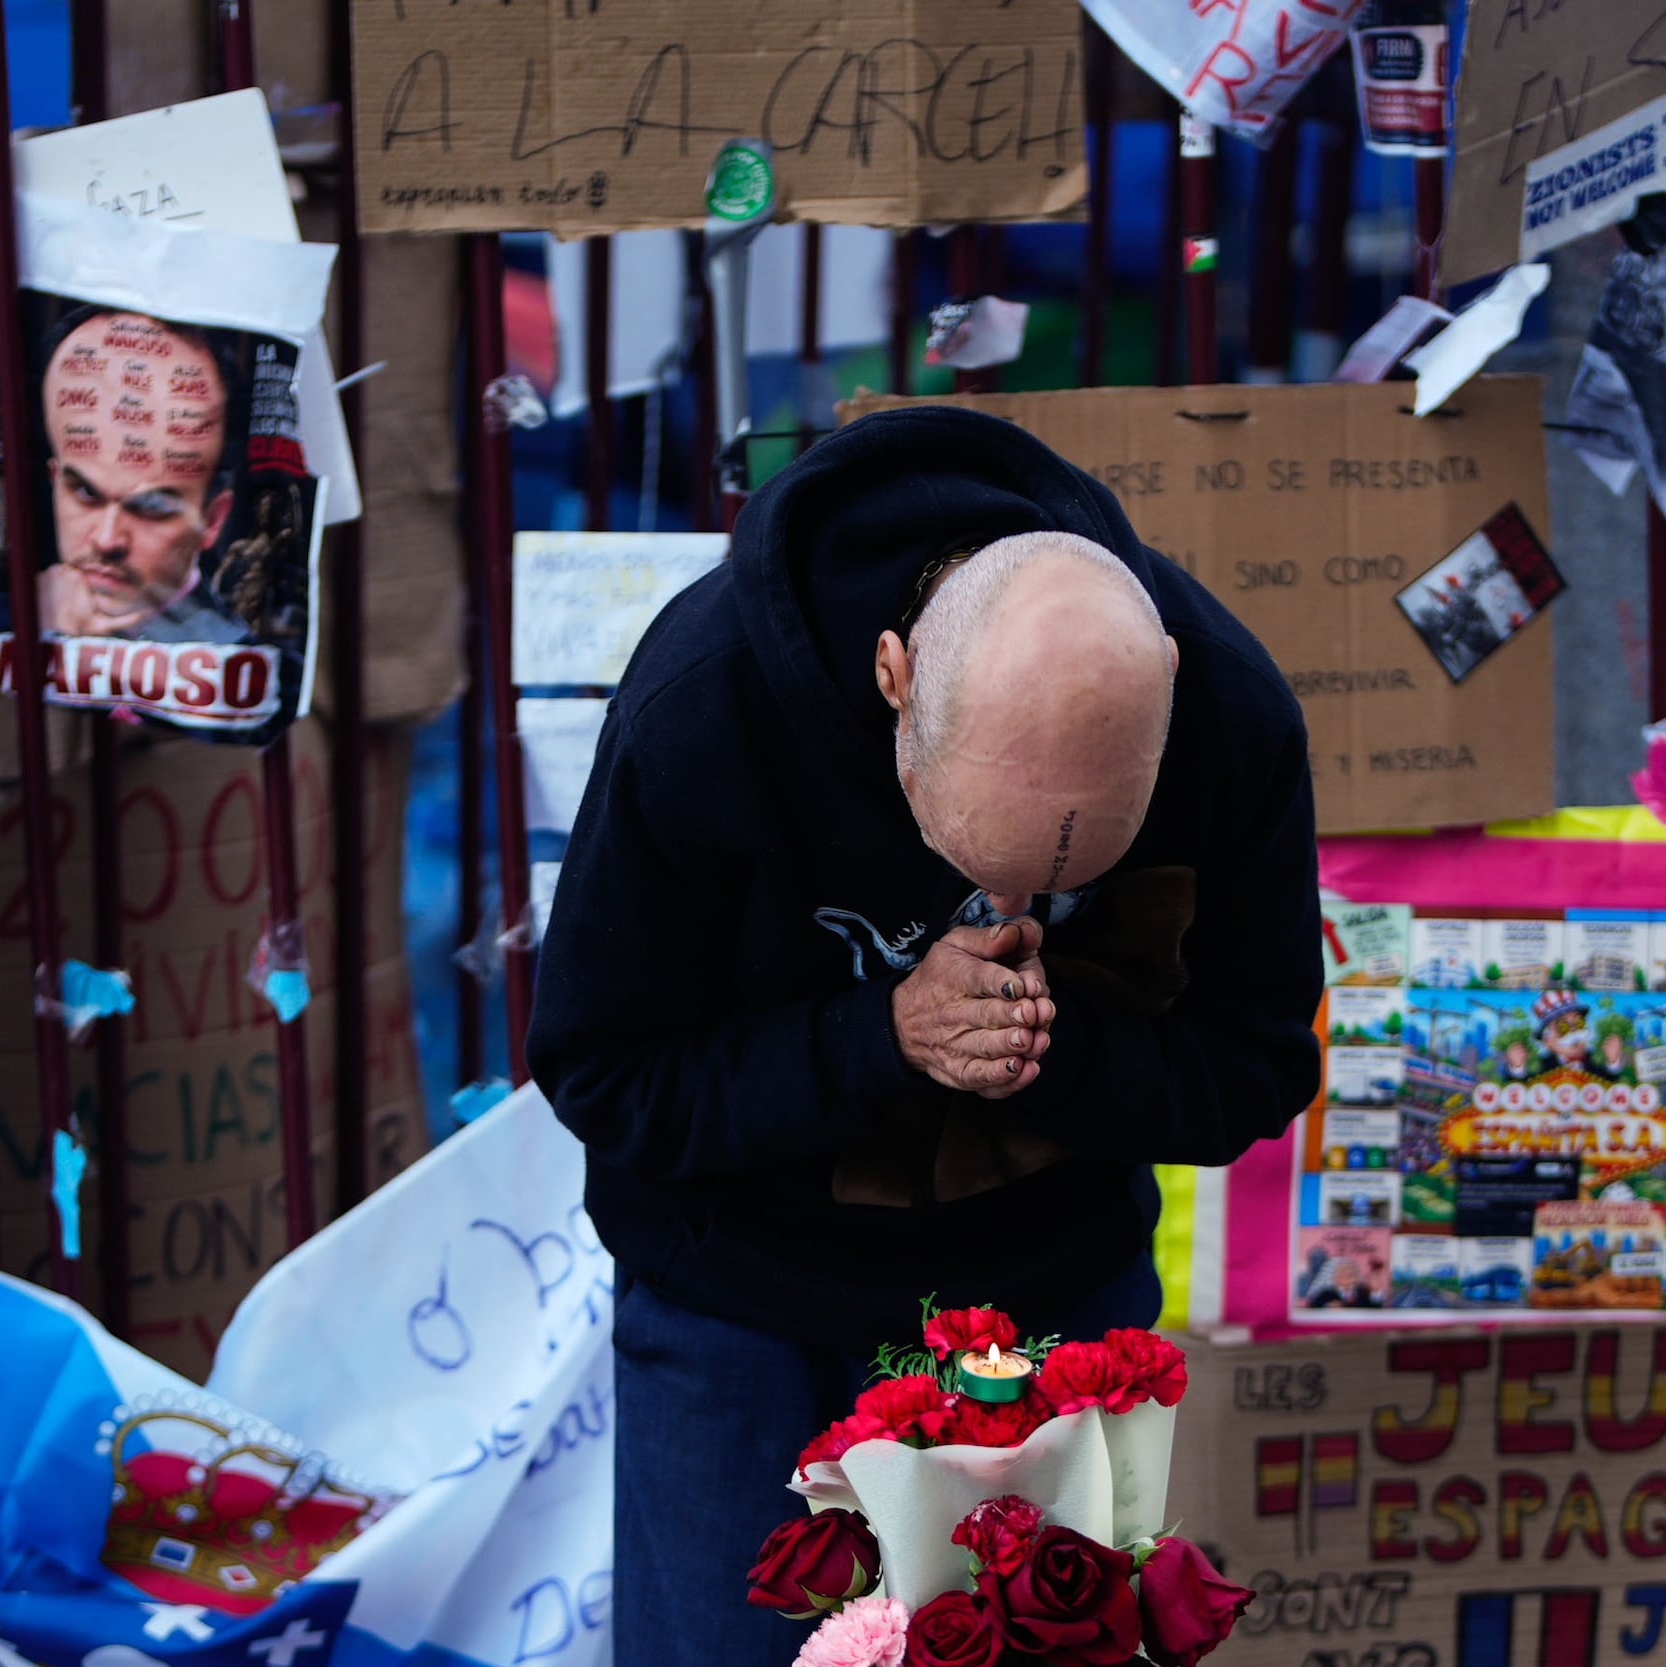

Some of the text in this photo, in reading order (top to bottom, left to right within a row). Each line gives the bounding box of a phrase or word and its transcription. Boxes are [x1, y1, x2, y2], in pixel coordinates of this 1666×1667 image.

[511, 43, 745, 160] LA
[1527, 122, 1658, 205] ZIONISTS
[1570, 149, 1657, 212] WELCOME
[1195, 456, 1482, 491] NO SE PRESENTA
[1235, 554, 1407, 590] SINO COMO
[1476, 1083, 1656, 1108] WELCOME
[1231, 1364, 1327, 1411] LES
